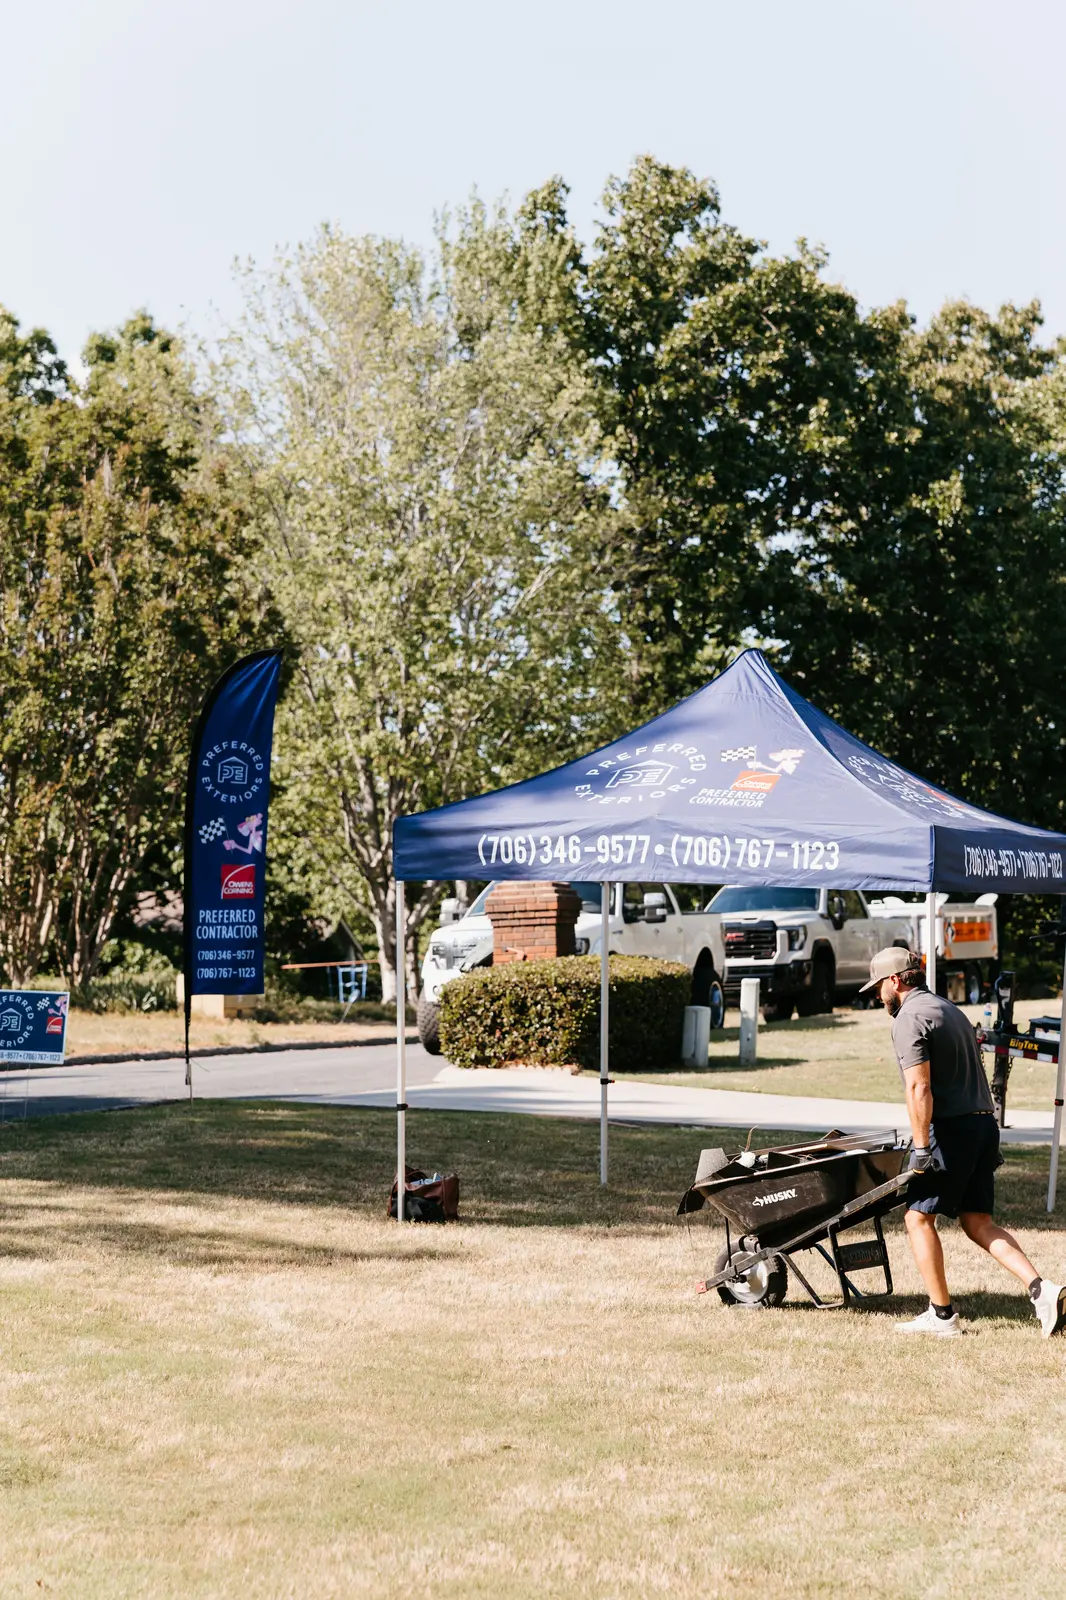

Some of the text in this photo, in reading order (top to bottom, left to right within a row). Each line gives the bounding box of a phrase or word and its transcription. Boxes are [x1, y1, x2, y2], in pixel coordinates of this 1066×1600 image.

[202, 740, 264, 770] PREFERRED
[585, 743, 707, 776] PREFERRED
[201, 776, 263, 803] EXTERIORS
[574, 777, 697, 804] EXTERIORS
[698, 787, 767, 800] PREFERRED
[689, 796, 764, 808] CONTRACTOR
[477, 833, 840, 871] (706)346-9577 (706)767-1123
[199, 909, 256, 923] PREFERRED
[196, 925, 258, 939] CONTRACTOR
[197, 950, 255, 961] (706)346-9577
[196, 967, 256, 979] (706)767-1123
[763, 1189, 796, 1205] HUSKY
